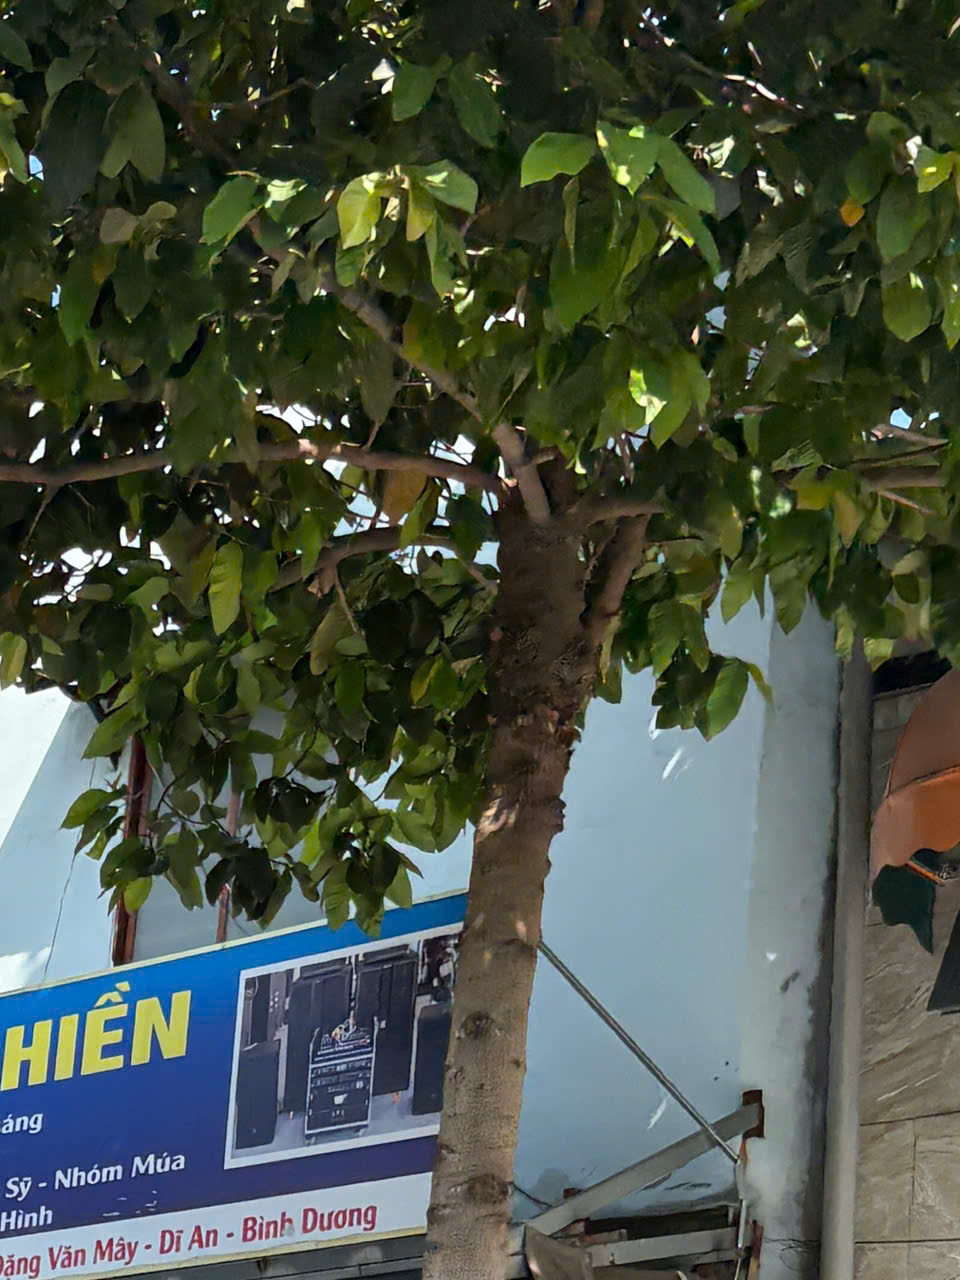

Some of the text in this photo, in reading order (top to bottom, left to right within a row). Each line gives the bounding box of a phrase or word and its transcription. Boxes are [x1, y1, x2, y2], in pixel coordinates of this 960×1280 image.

[0, 981, 192, 1091] HIỀN
[5, 1176, 32, 1201] Sỹ
[54, 1163, 123, 1190] Nhóm
[131, 1151, 186, 1178] Múa
[0, 1205, 53, 1232] Hình
[47, 1244, 86, 1271] Văn
[93, 1236, 140, 1266] Mây
[159, 1229, 184, 1255] Dĩ
[187, 1224, 218, 1251] An
[242, 1211, 294, 1243] Bình
[301, 1204, 378, 1235] Dương
